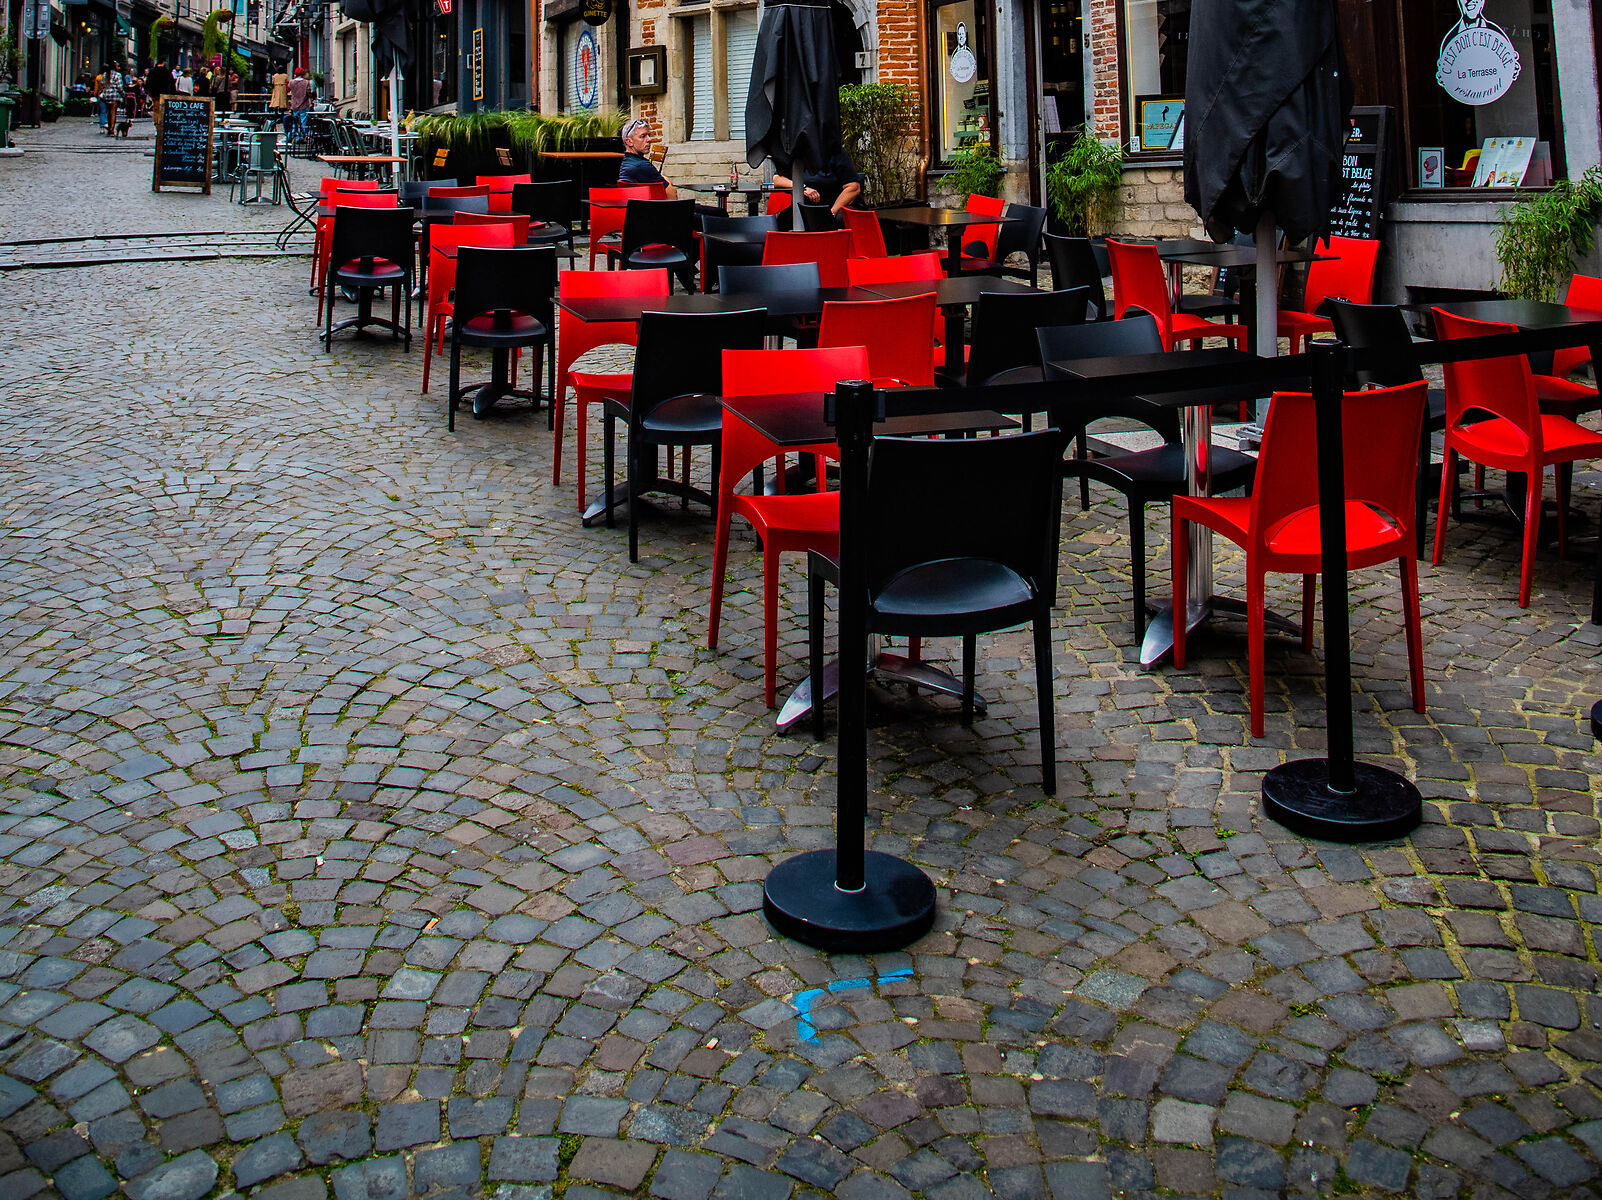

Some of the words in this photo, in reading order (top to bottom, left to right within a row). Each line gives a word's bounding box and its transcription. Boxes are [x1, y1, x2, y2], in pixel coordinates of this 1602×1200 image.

[583, 9, 607, 19] GINETTE
[1084, 33, 1090, 48] 5
[1441, 47, 1459, 75] C'EST
[1456, 34, 1472, 56] BON
[1472, 31, 1493, 48] C'EST
[1492, 37, 1514, 69] BELGE
[859, 53, 866, 67] 7
[1457, 69, 1467, 79] La
[1467, 67, 1497, 78] Terrasse
[1454, 78, 1503, 99] restaurant
[1146, 122, 1175, 130] PAPEGA
[1342, 154, 1358, 167] BON
